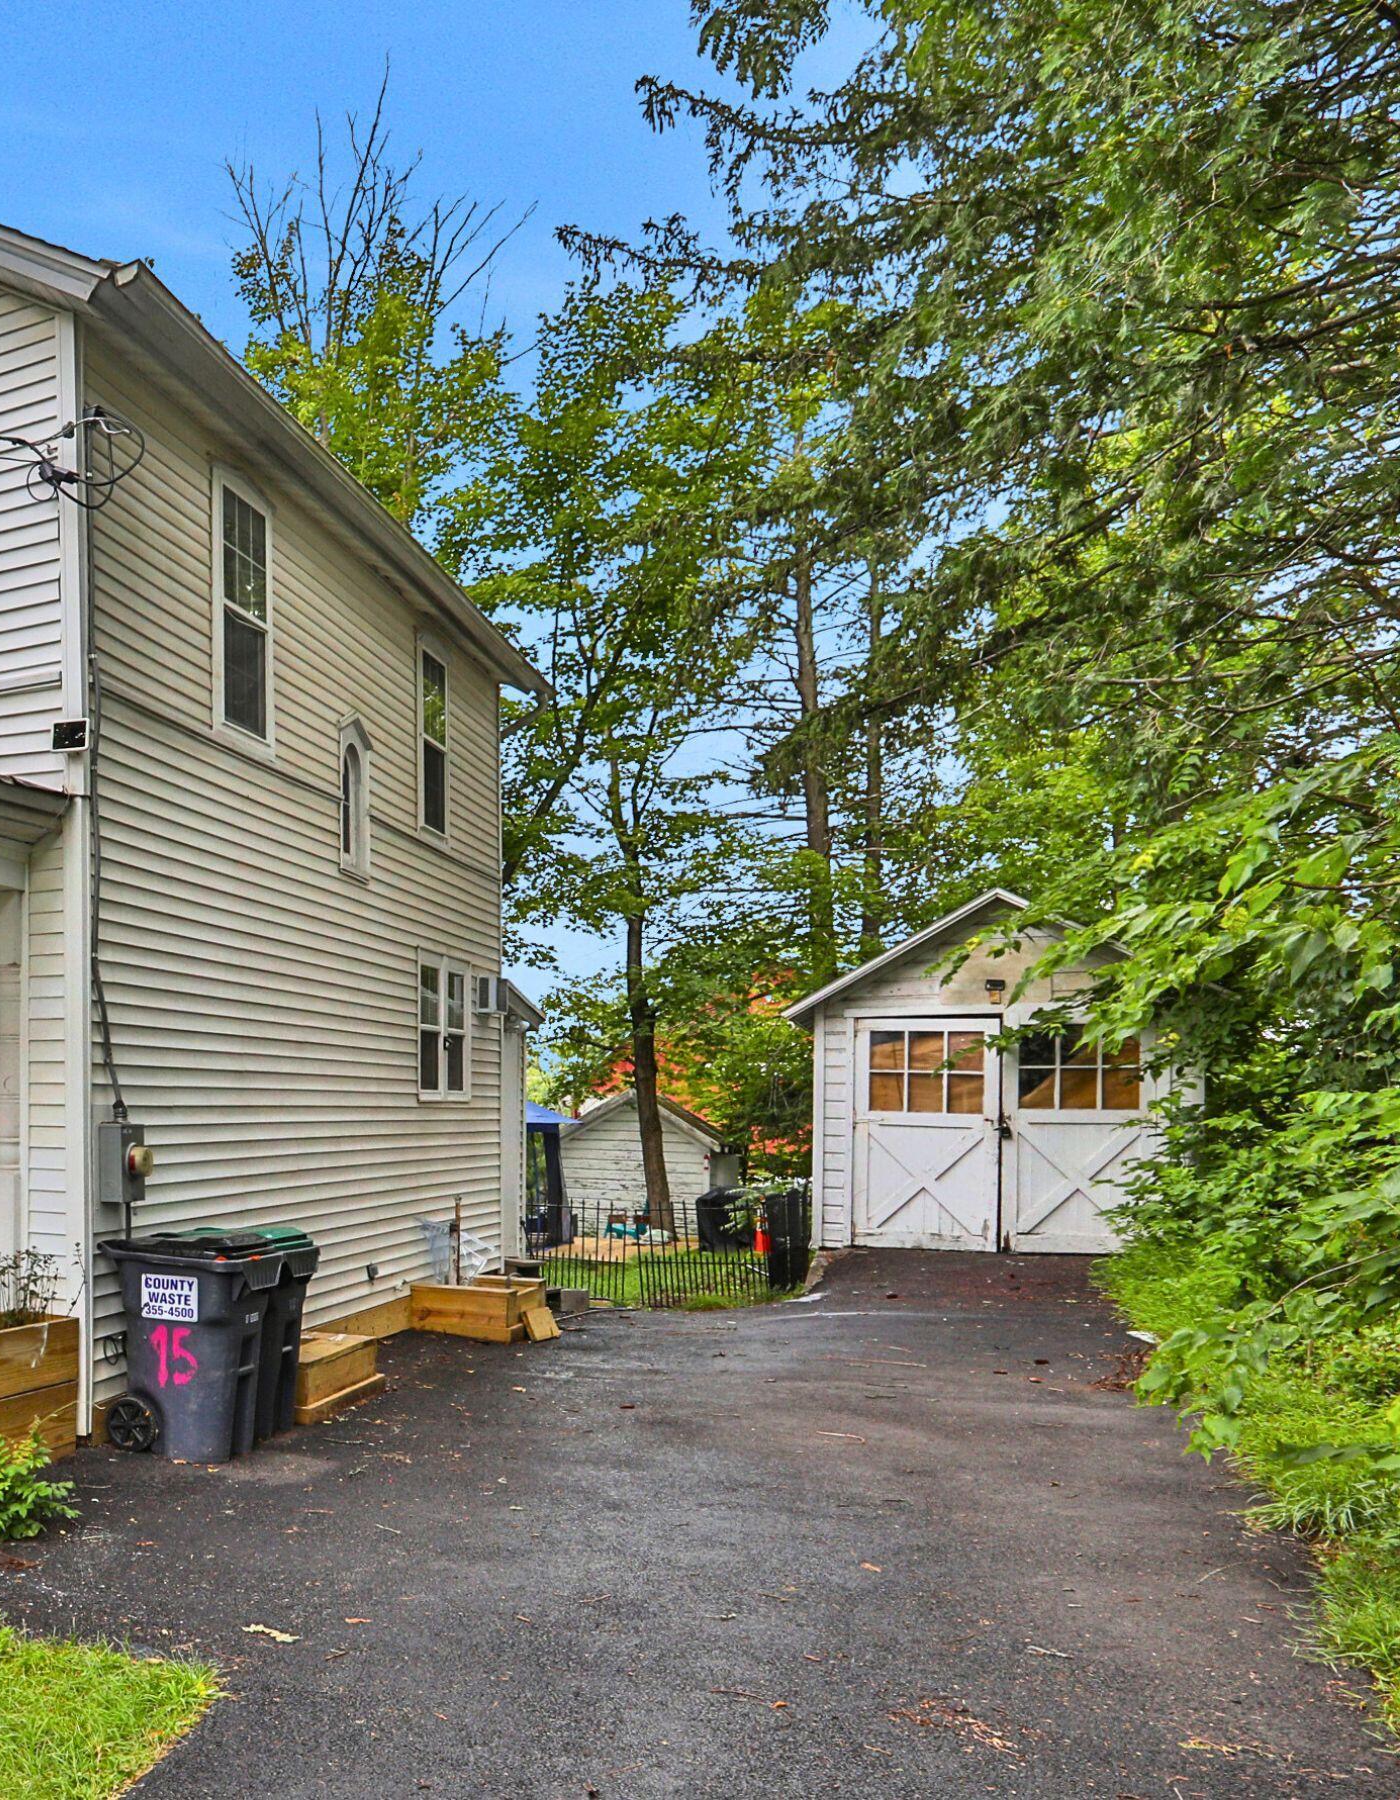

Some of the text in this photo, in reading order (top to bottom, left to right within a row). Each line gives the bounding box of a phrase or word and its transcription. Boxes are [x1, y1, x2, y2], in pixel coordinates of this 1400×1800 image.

[144, 1277, 195, 1292] COUNTY
[148, 1291, 192, 1306] WASTE
[145, 1303, 194, 1319] 355-4500
[151, 1323, 199, 1389] 15
